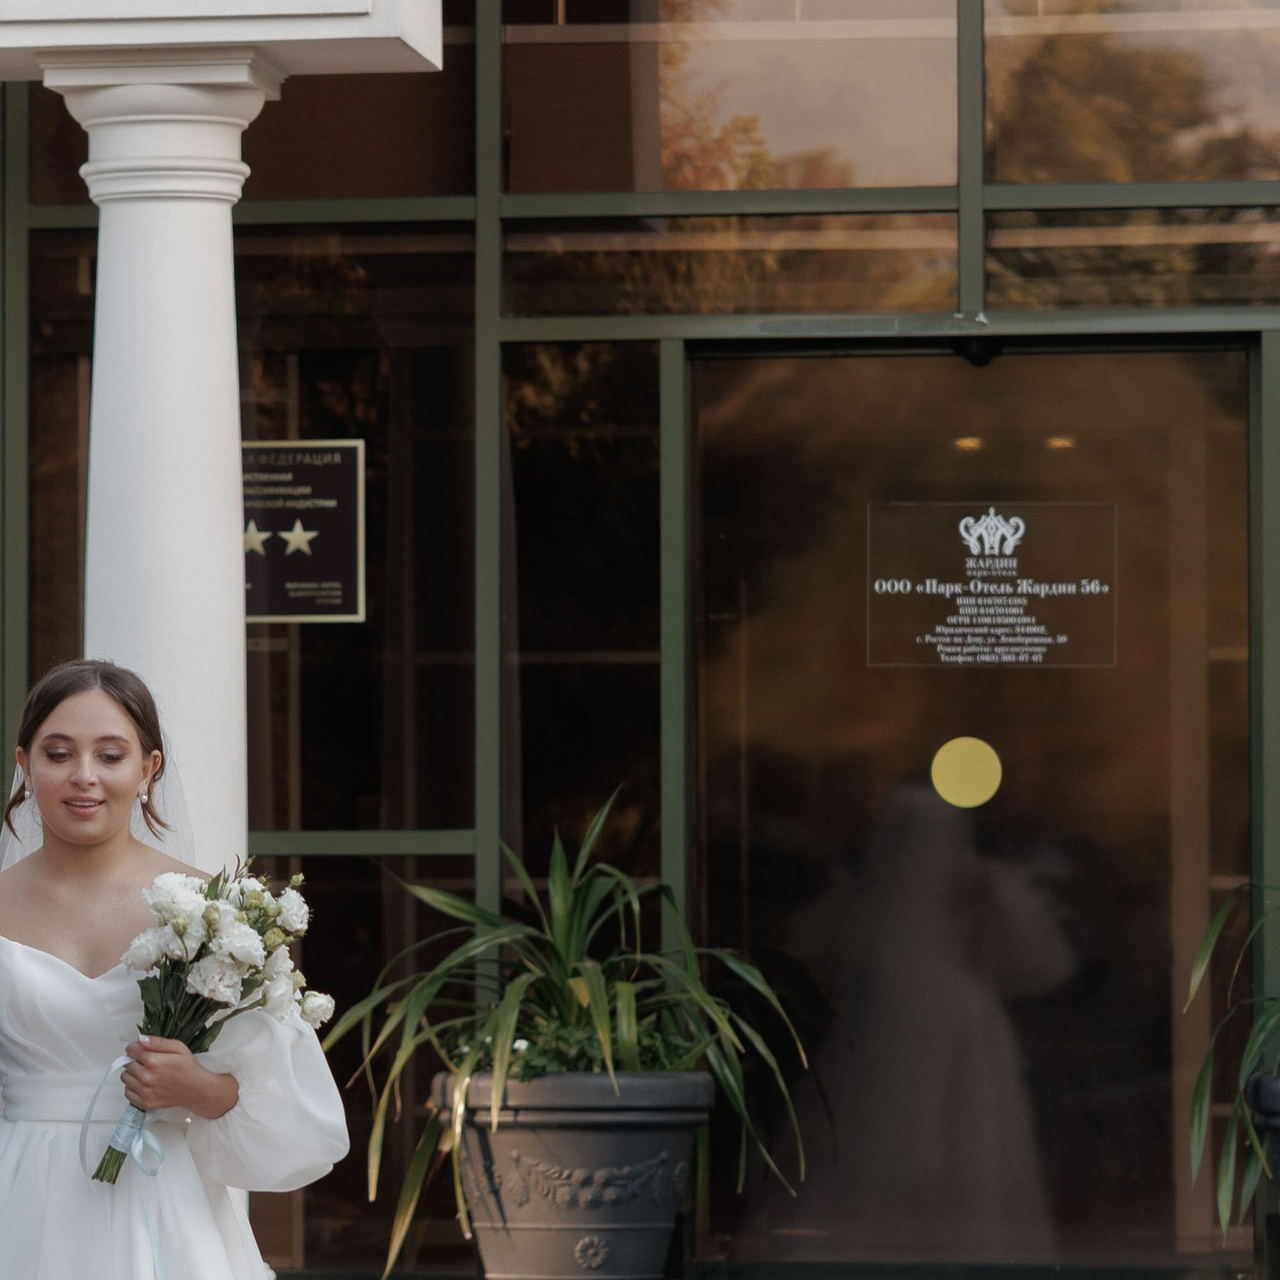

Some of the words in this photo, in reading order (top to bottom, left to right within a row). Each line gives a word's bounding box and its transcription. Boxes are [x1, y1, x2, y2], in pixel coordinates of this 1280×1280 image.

[965, 557, 1018, 570] ЖАРДИН
[874, 578, 912, 594] ООО
[916, 578, 1014, 598] «Парк-Отель
[1016, 578, 1077, 598] Жардин
[1080, 578, 1111, 594] 56»
